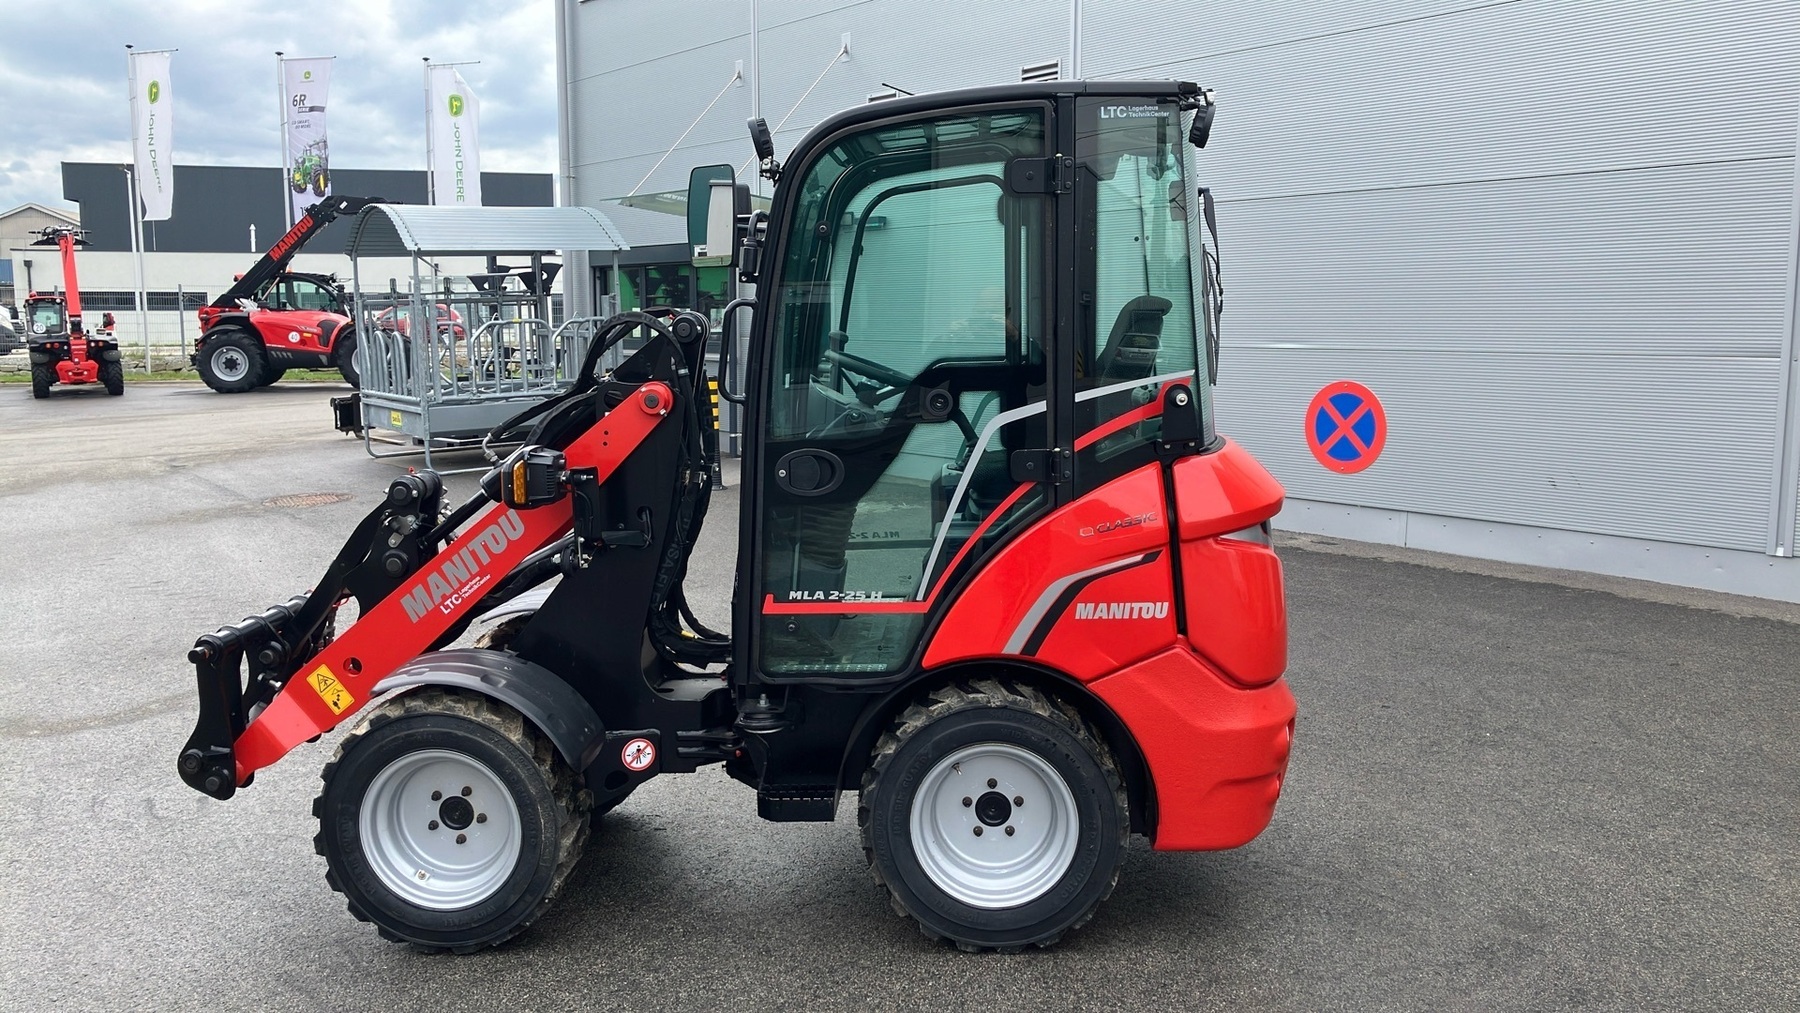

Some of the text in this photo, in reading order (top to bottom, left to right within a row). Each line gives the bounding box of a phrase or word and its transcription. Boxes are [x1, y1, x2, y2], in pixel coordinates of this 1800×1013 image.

[292, 94, 307, 107] 6R
[1100, 105, 1127, 118] LTC
[454, 122, 464, 202] JOHN DEERE
[269, 214, 314, 261] MANITOU
[291, 333, 298, 341] 40
[1096, 511, 1158, 533] CLASSIC
[400, 509, 525, 624] MANITOU
[439, 594, 462, 614] LTC
[788, 591, 883, 600] MLA 2-25 H
[1074, 602, 1169, 620] MANITOU
